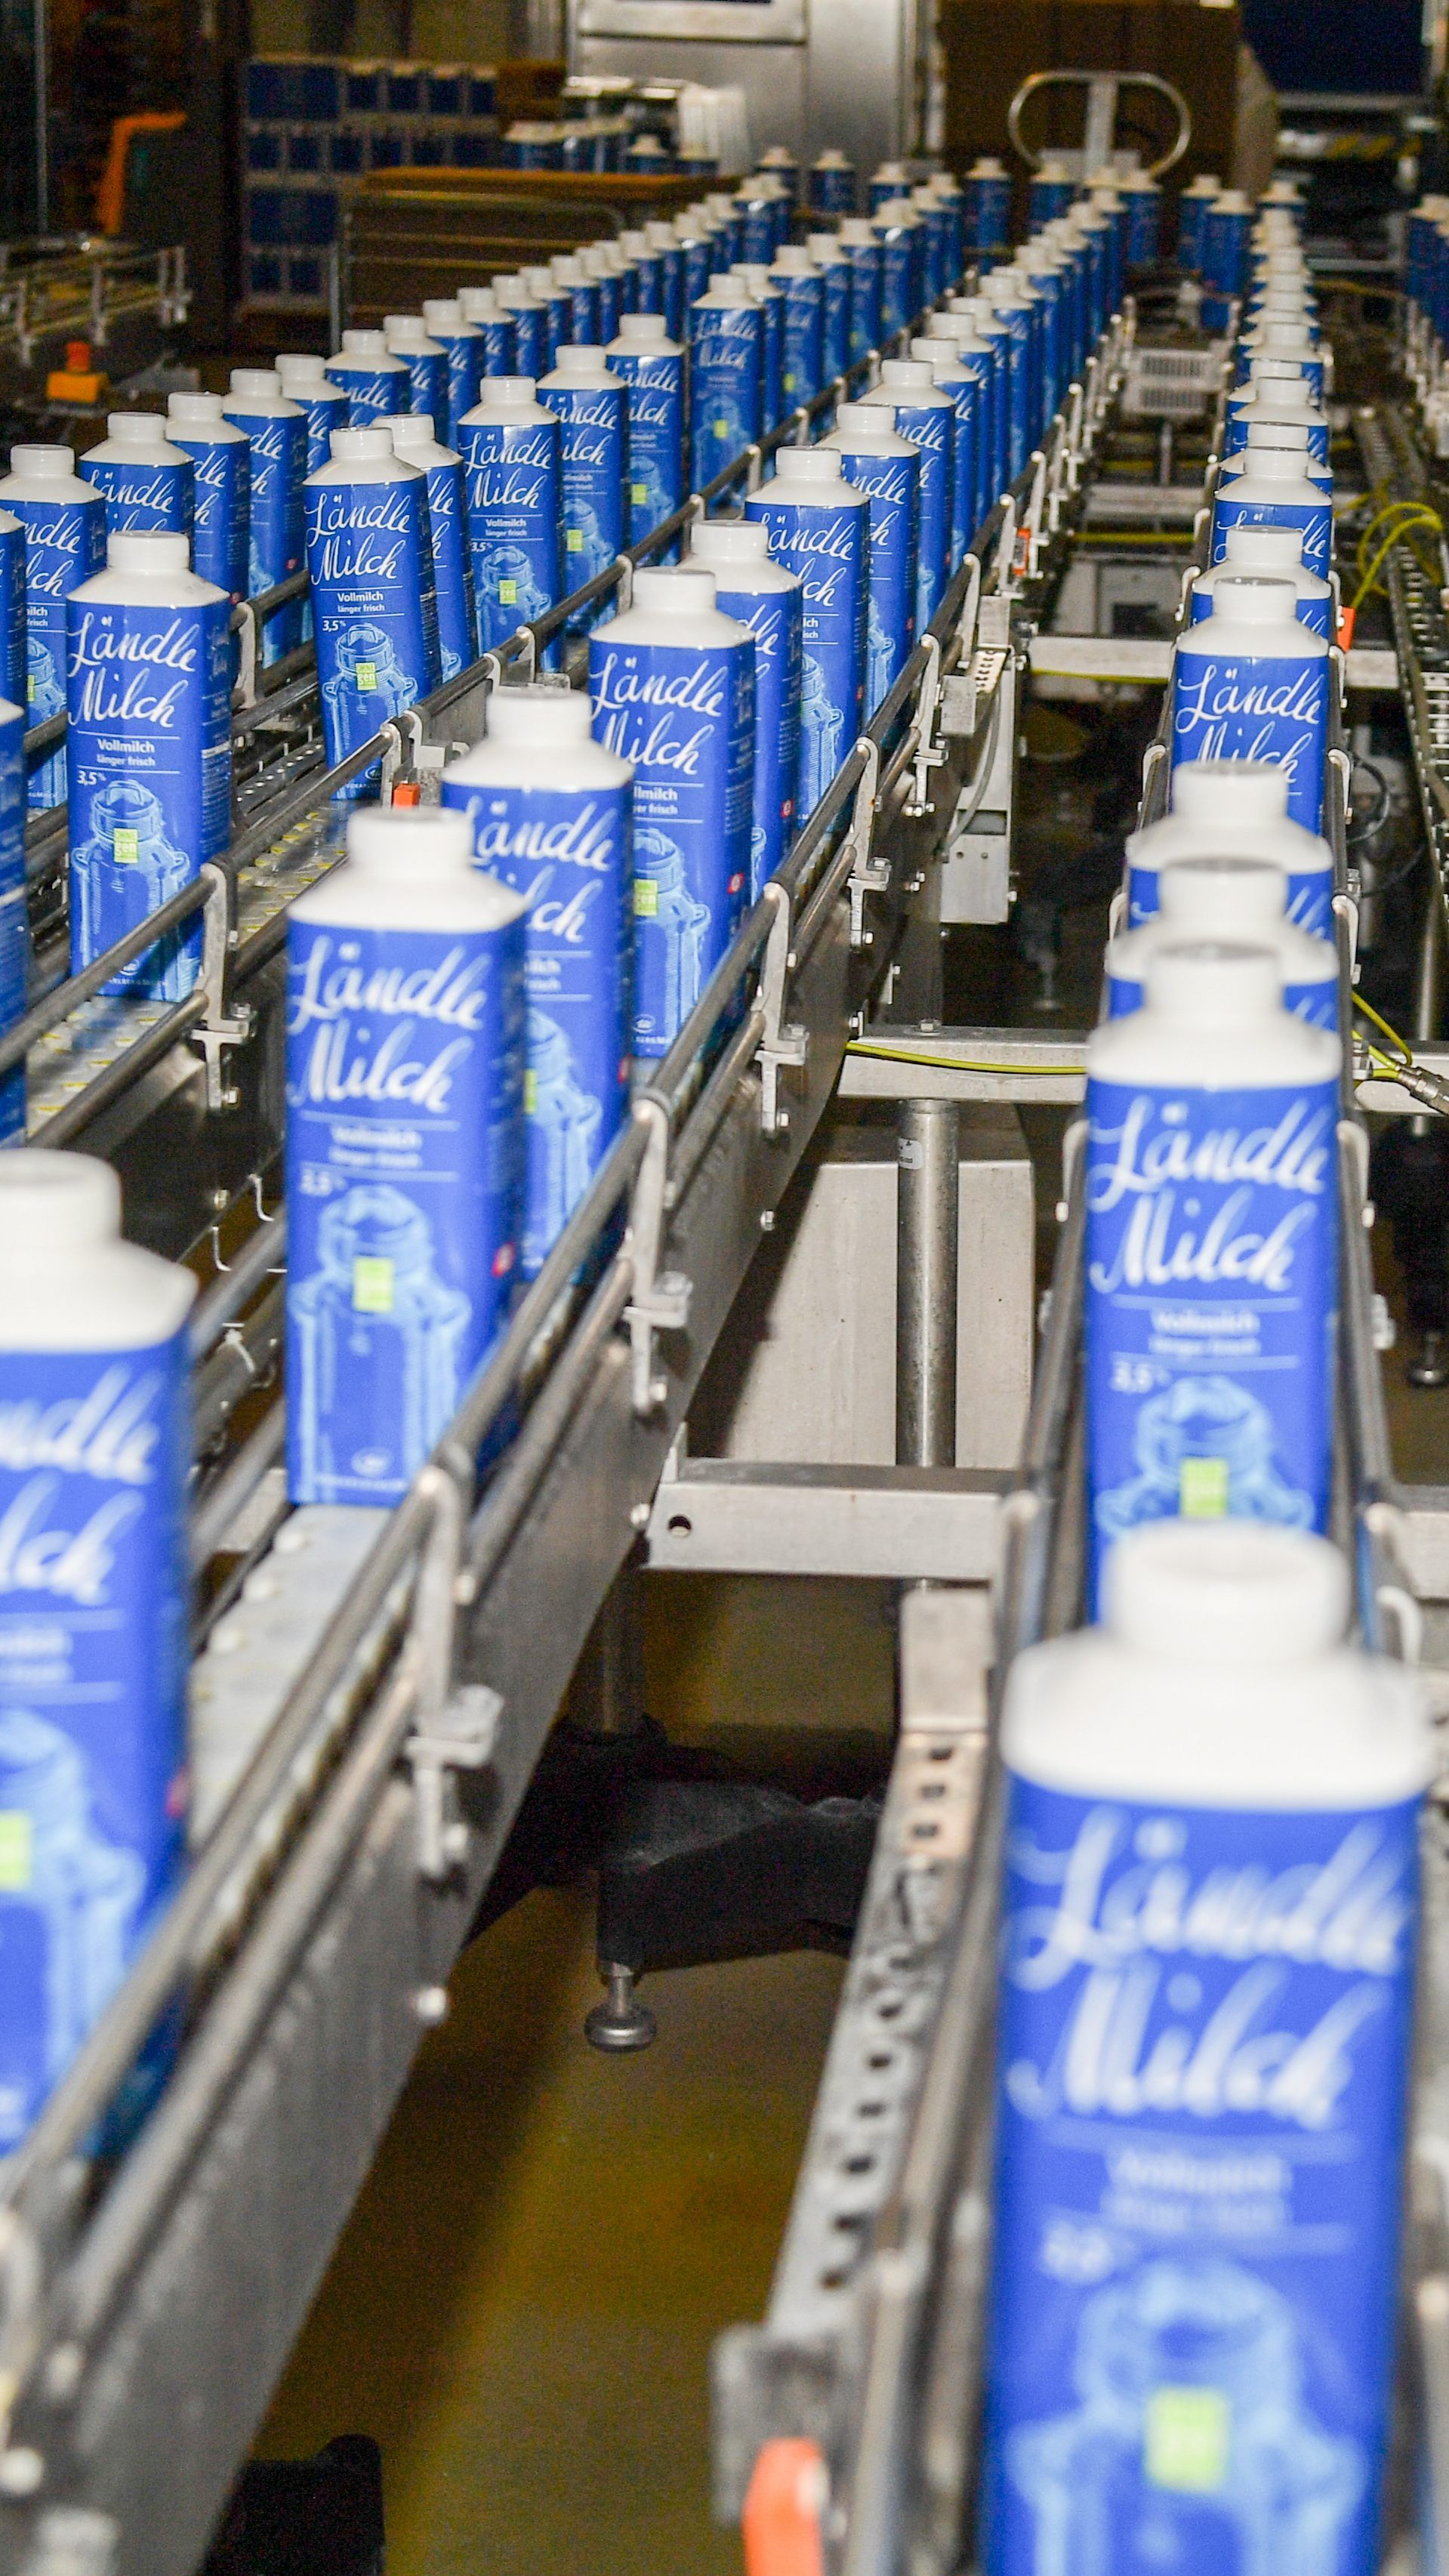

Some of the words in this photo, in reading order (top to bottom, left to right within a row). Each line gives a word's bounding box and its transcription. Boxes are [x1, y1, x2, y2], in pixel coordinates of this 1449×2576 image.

[628, 393, 674, 425] ilch
[896, 416, 945, 452] ndle
[459, 431, 553, 477] Ländle
[561, 427, 613, 465] ilch
[467, 467, 548, 511] Milch
[842, 464, 908, 505] ndle
[7, 509, 84, 554] ndle
[304, 490, 412, 548] Ländle
[26, 549, 75, 597] lch
[310, 532, 406, 586] Milch
[337, 591, 384, 603] Vollmilch
[338, 604, 361, 615] länger
[362, 603, 386, 612] frisch
[66, 611, 201, 678] Ländle
[67, 667, 189, 729] Milch
[589, 652, 729, 720] Ländle
[1175, 664, 1325, 734] Ländle
[97, 737, 156, 754] Vollmilch
[128, 754, 156, 767] frisch
[603, 710, 715, 776] Milch
[633, 785, 678, 801] llmilch
[287, 935, 493, 1036] Ländle
[286, 1018, 475, 1114] Milch
[1088, 1094, 1332, 1214] Ländle
[1088, 1186, 1318, 1294] Milch
[1007, 1803, 1413, 1994] Ländle
[1005, 1954, 1394, 2132] Milch
